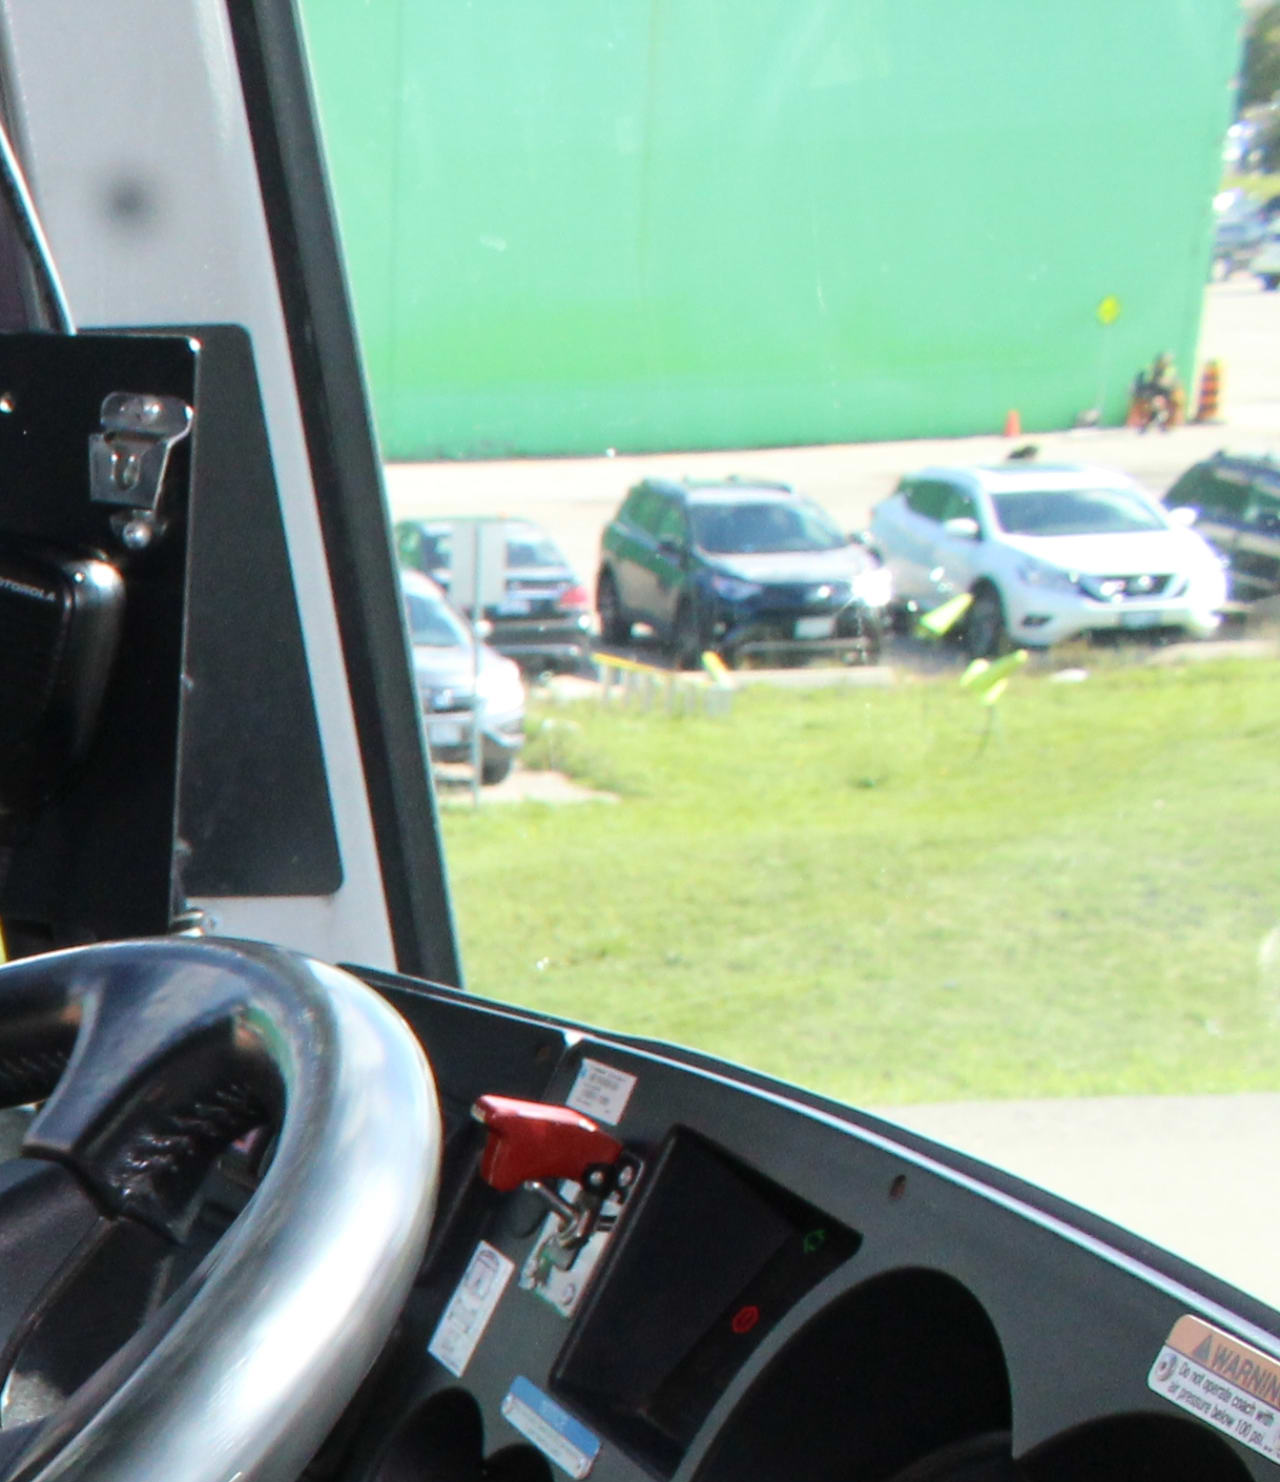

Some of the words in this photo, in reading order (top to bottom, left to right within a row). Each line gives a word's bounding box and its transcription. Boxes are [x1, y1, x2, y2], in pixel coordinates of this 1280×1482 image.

[1176, 1388, 1212, 1414] pressure
[1210, 1405, 1234, 1428] below
[1235, 1419, 1252, 1438] 100
[1179, 1361, 1190, 1378] Do
[1192, 1370, 1205, 1385] not
[1202, 1379, 1232, 1403] operate
[1231, 1395, 1256, 1416] coach
